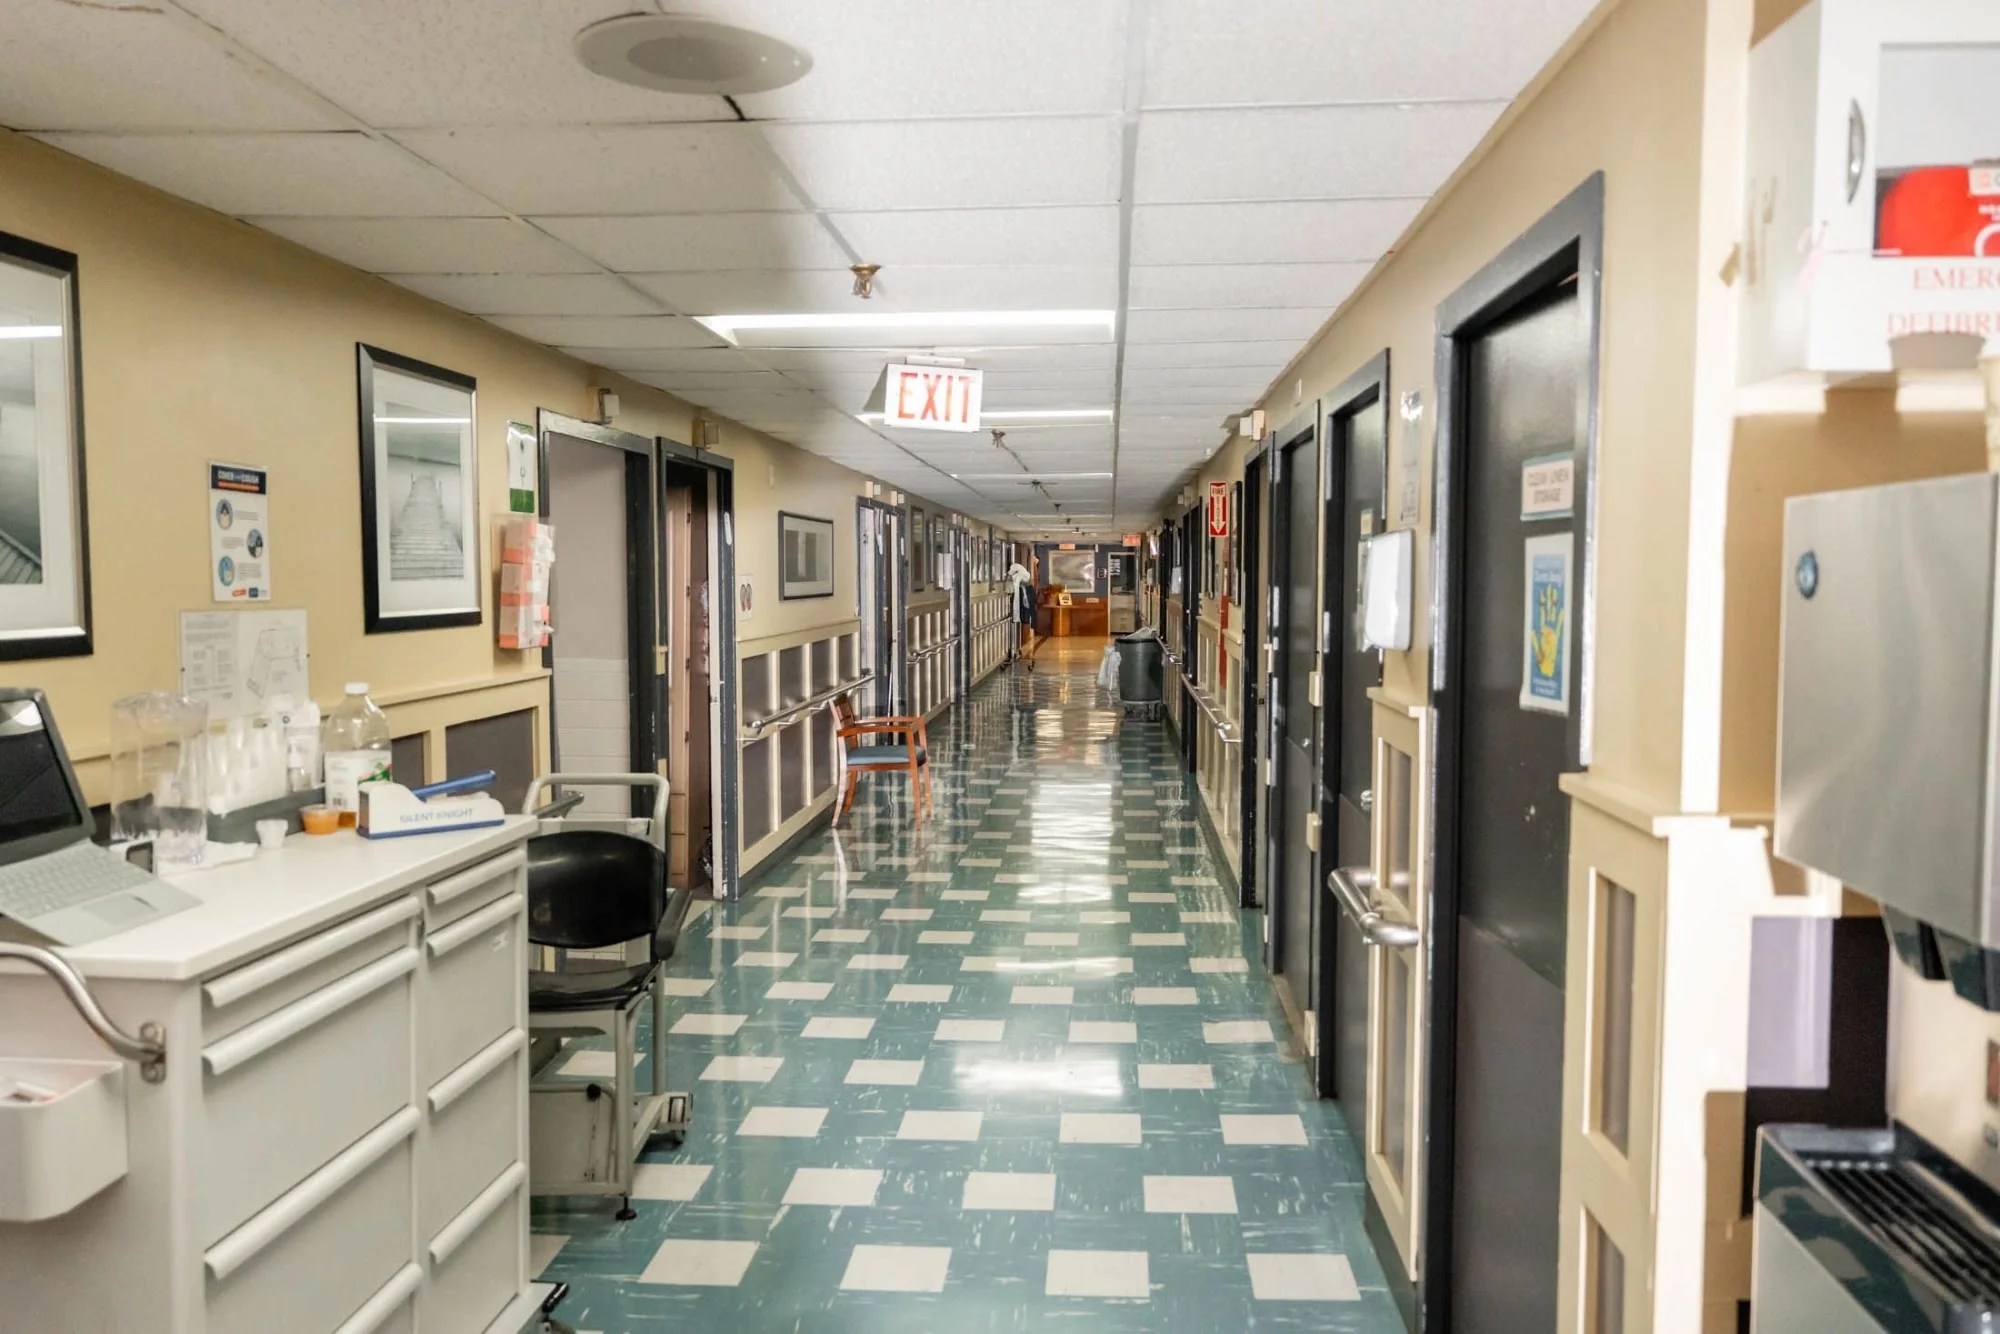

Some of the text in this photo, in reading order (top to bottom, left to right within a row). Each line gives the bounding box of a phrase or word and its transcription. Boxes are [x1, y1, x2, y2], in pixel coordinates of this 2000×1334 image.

[898, 371, 973, 424] EXIT
[1212, 487, 1225, 496] FIRE
[400, 807, 473, 823] SILENT KNIGHT
